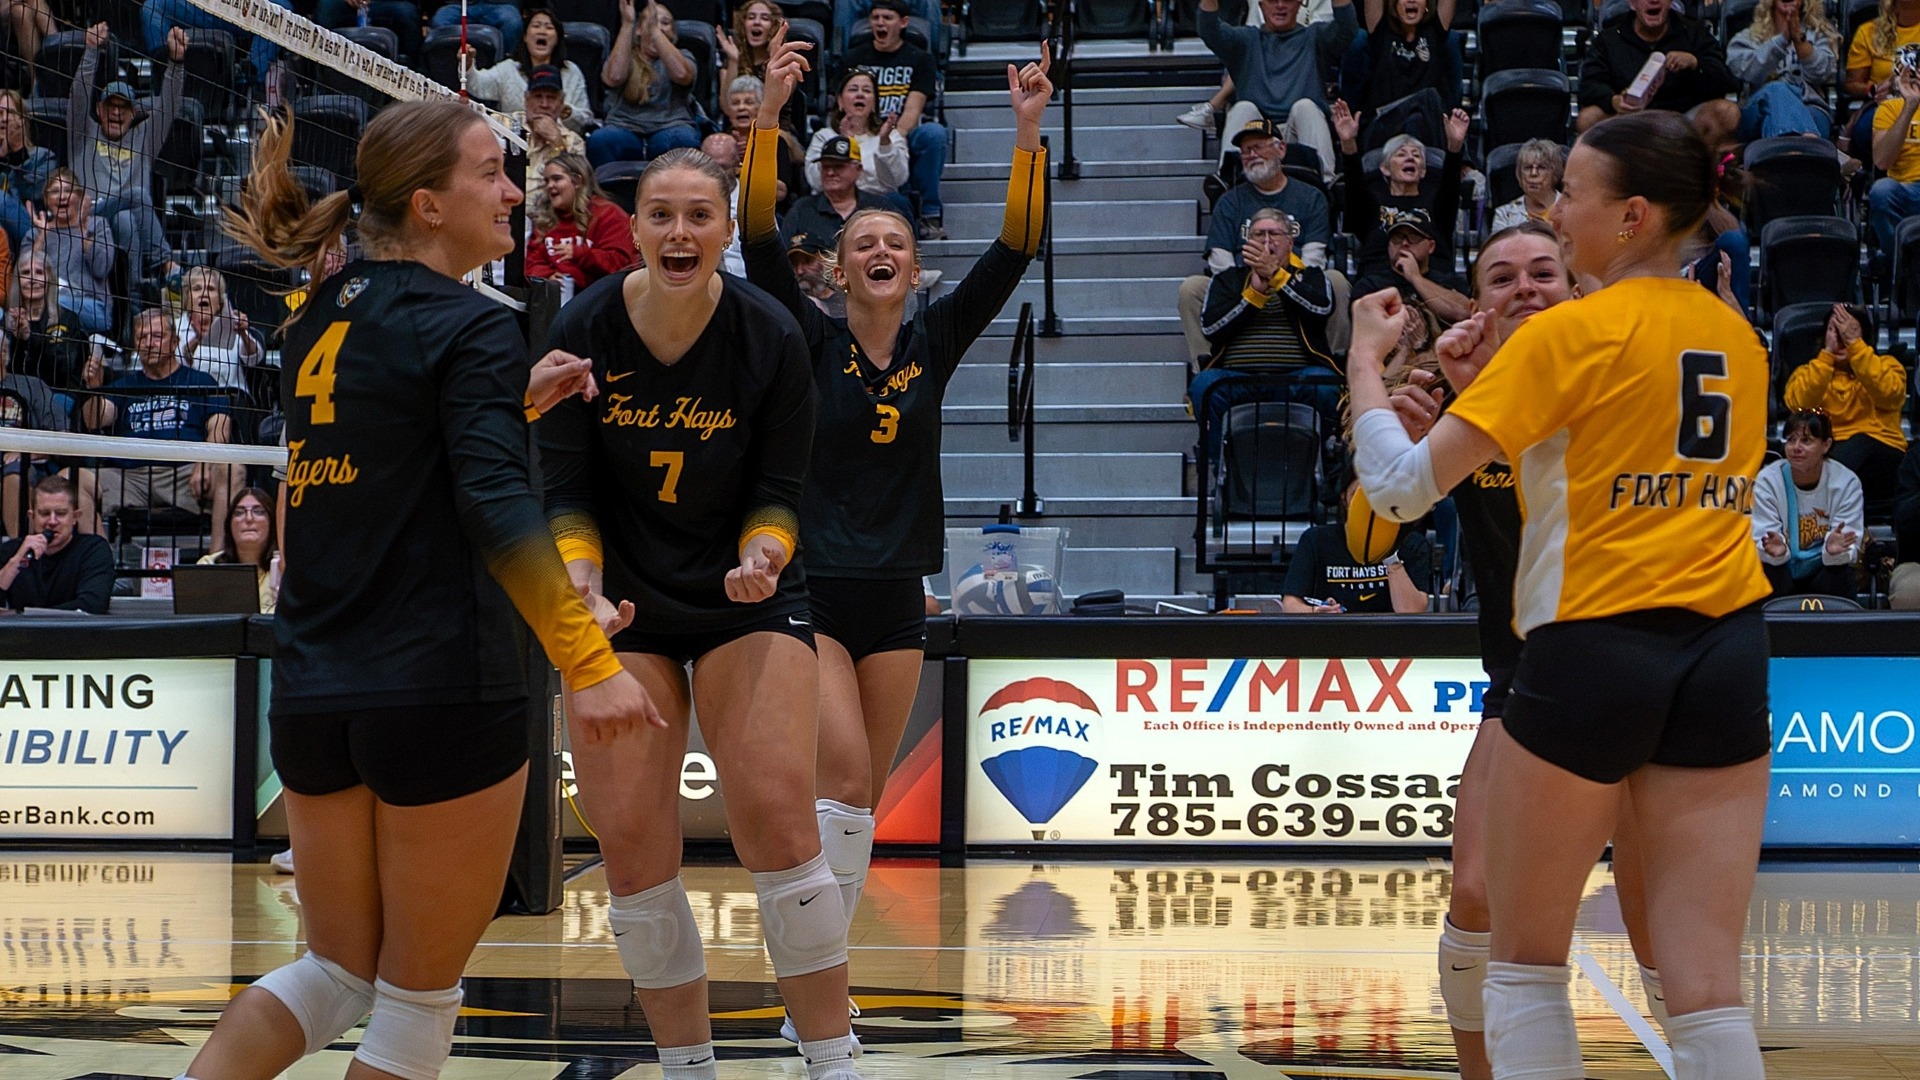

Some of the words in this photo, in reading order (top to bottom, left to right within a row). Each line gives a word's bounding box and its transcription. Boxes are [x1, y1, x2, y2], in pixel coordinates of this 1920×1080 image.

[871, 66, 913, 85] TIGER
[295, 321, 351, 425] 4
[603, 393, 660, 428] Fort
[665, 397, 737, 440] Hays
[870, 403, 900, 443] 3
[1674, 349, 1732, 463] 6
[287, 438, 359, 507] Tigers
[650, 451, 684, 503] 7
[1610, 473, 1692, 510] FORT
[1326, 566, 1351, 578] FORT
[1352, 566, 1376, 578] HAYS
[0, 674, 154, 709] ATING
[1116, 659, 1414, 713] RE/MAX
[991, 715, 1090, 742] RE/MAX
[1143, 720, 1179, 731] Each
[1182, 720, 1225, 731] Office
[1228, 720, 1240, 731] is
[1243, 720, 1351, 734] Independently
[1354, 720, 1404, 731] Owned
[1408, 720, 1436, 731] and
[0, 729, 190, 765] IBILITY
[1110, 763, 1234, 798] Tim
[1110, 802, 1454, 838] 785-639-63
